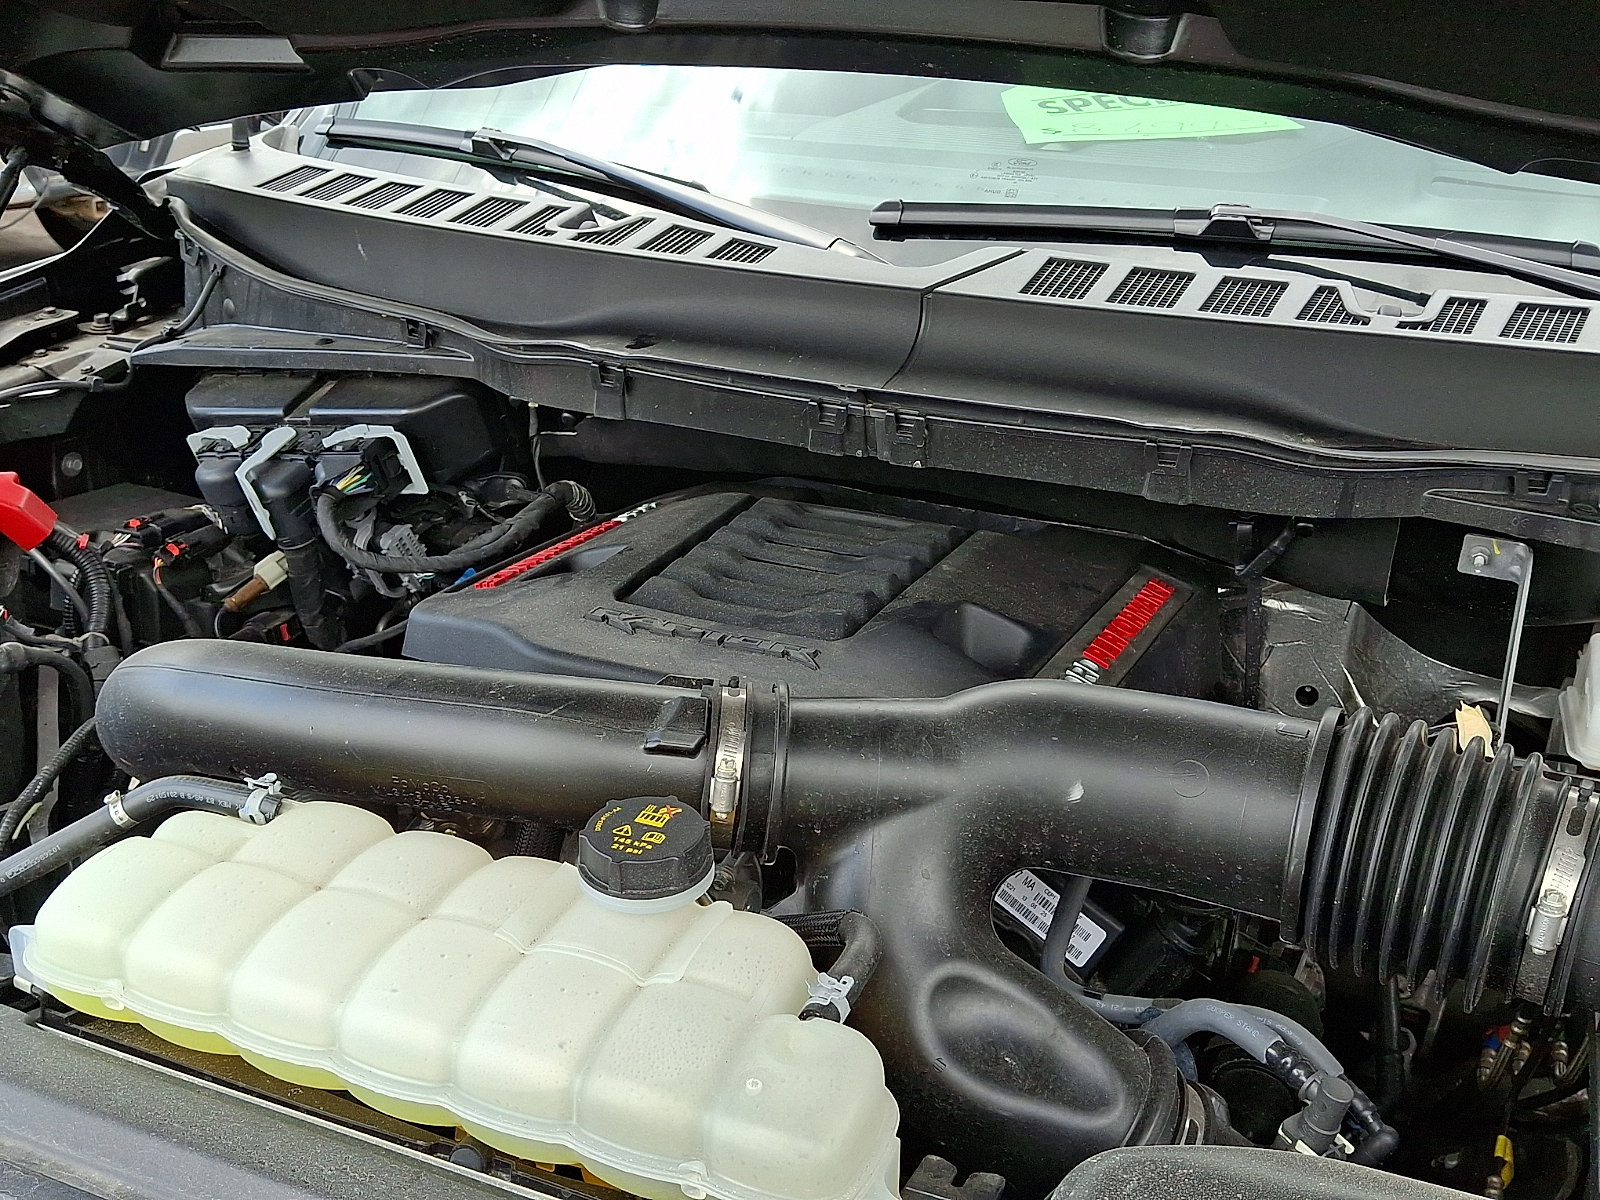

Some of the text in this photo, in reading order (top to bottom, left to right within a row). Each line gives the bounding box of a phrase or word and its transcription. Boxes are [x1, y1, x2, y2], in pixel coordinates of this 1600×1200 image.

[1082, 577, 1175, 670] PERFORMANCE
[610, 843, 644, 856] 21 psi
[612, 836, 653, 850] 145 kPa
[1021, 875, 1036, 891] MA
